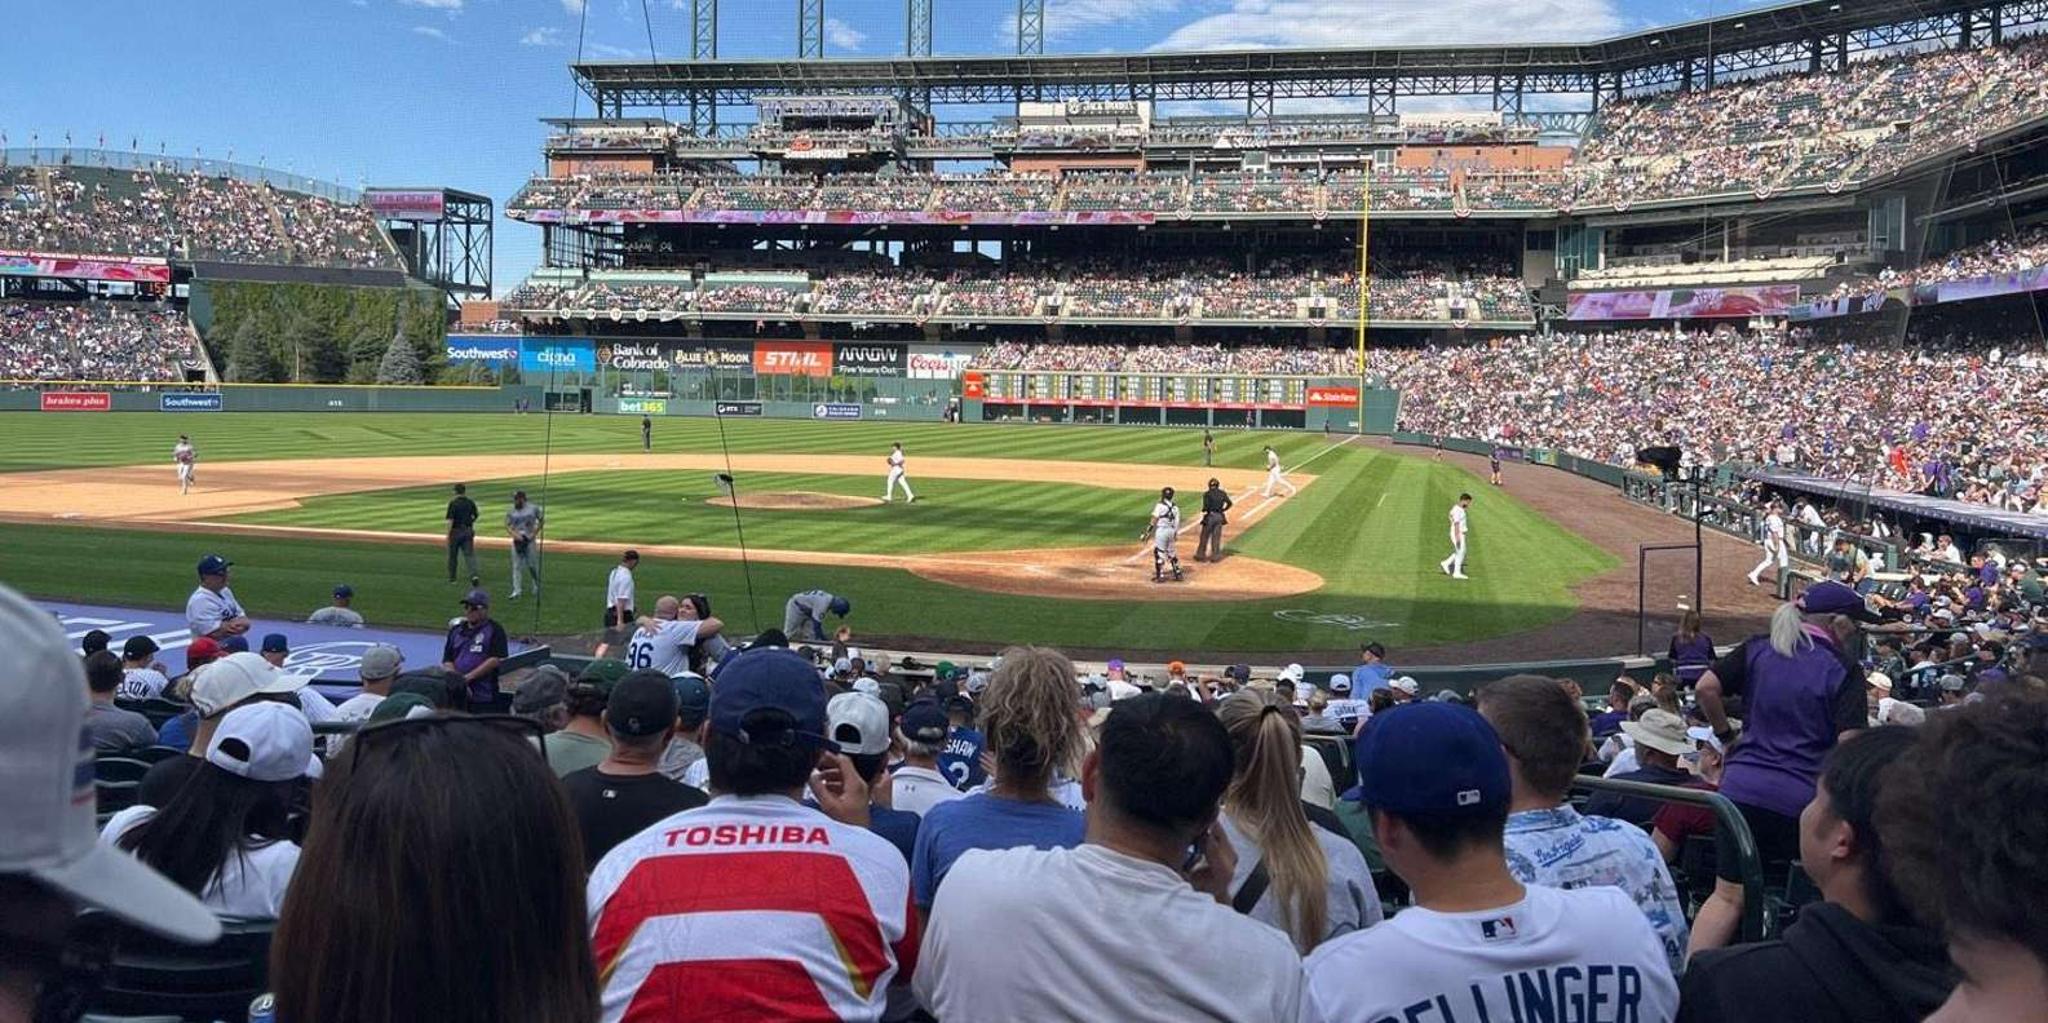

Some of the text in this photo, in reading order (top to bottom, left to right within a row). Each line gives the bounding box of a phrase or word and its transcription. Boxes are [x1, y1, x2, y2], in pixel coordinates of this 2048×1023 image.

[447, 347, 509, 360] Southwest
[613, 343, 659, 355] Bank of
[839, 347, 898, 362] ARROW
[537, 347, 576, 366] cigna
[613, 355, 669, 369] Colorado
[720, 352, 750, 363] MOON
[764, 351, 822, 365] STIHL
[910, 354, 949, 371] Coors
[839, 364, 897, 374] Five Years Out
[46, 397, 105, 408] brakes plus
[165, 398, 212, 407] Southwest
[621, 401, 664, 412] bet365
[664, 824, 830, 848] TOSHIBA
[1374, 965, 1643, 1023] LINGER
